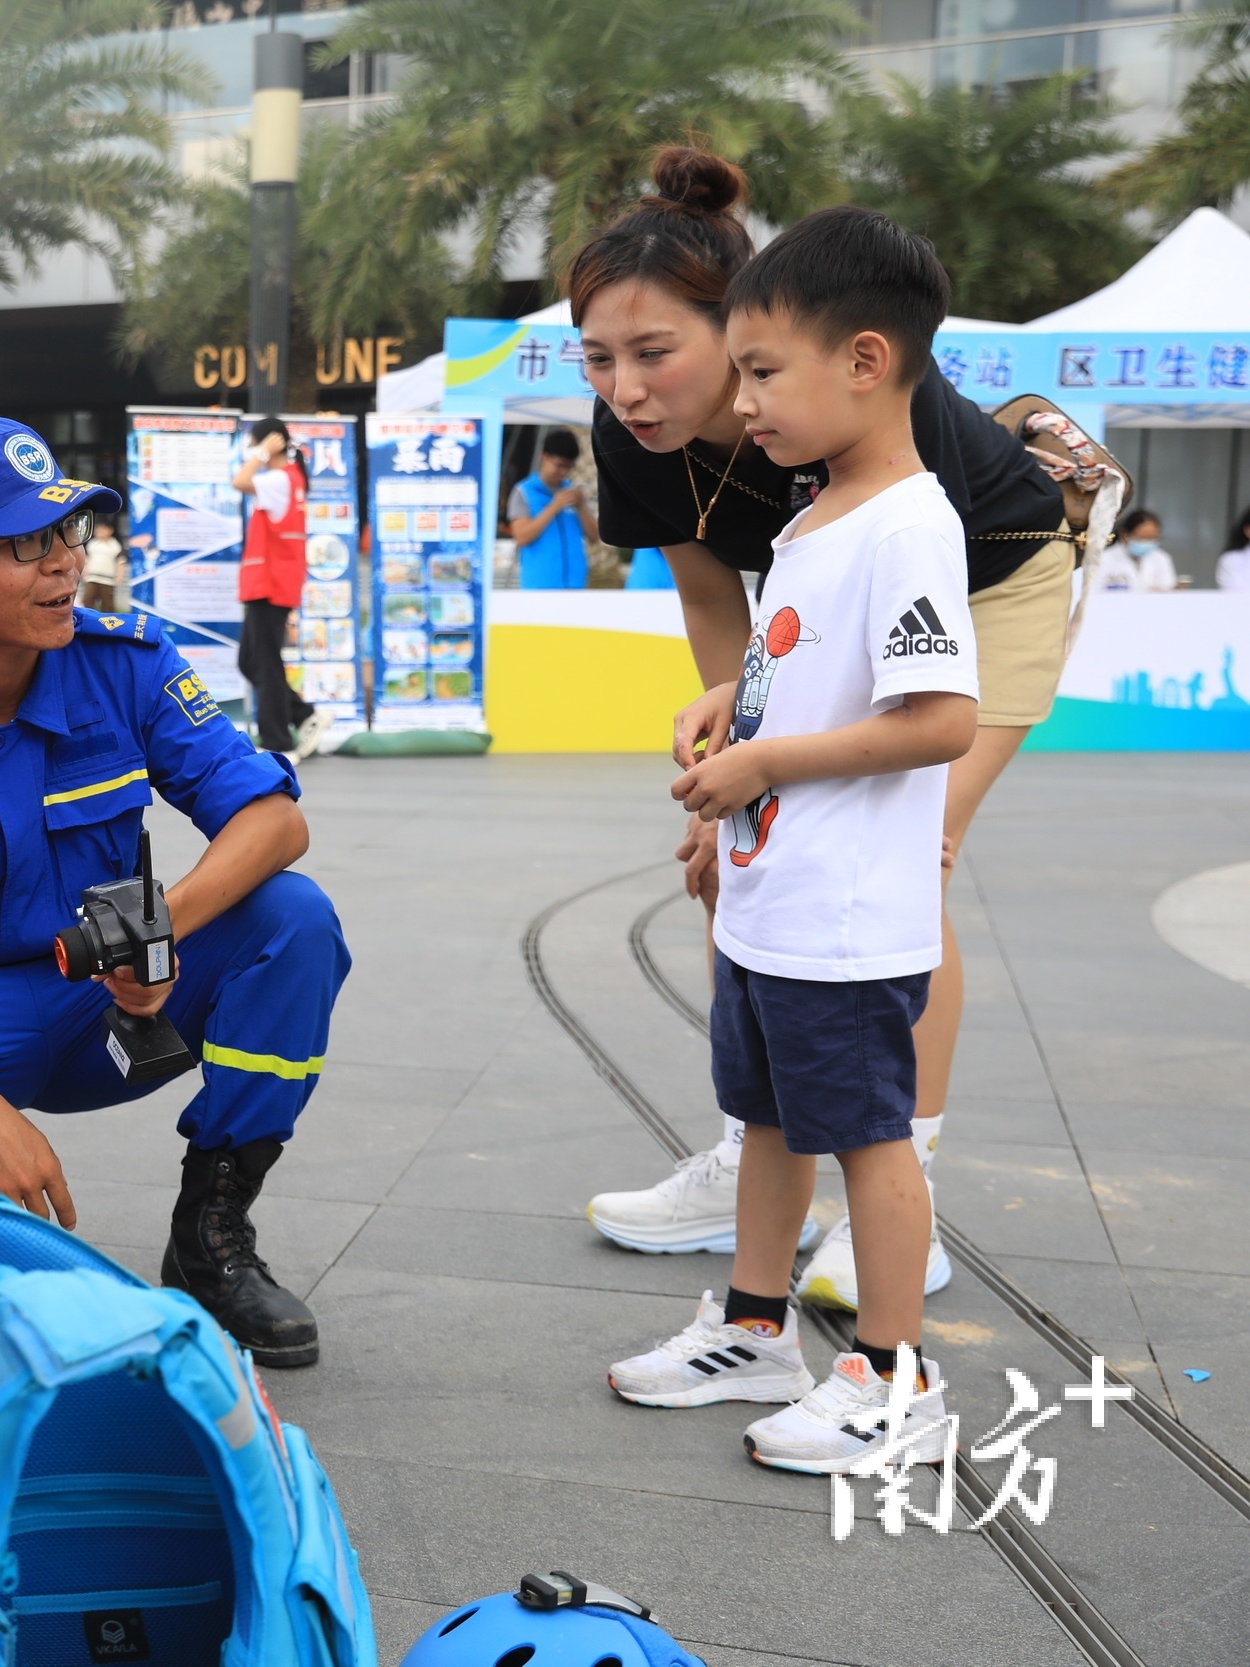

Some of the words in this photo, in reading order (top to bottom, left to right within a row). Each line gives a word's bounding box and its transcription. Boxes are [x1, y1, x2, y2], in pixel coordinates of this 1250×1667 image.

[194, 337, 403, 389] COMUNE
[19, 450, 43, 467] BSR
[391, 437, 466, 474] 暴雨
[37, 478, 92, 504] BS
[882, 632, 959, 661] adidas
[743, 659, 760, 679] 03
[178, 673, 208, 702] BS
[837, 1362, 867, 1385] adidas
